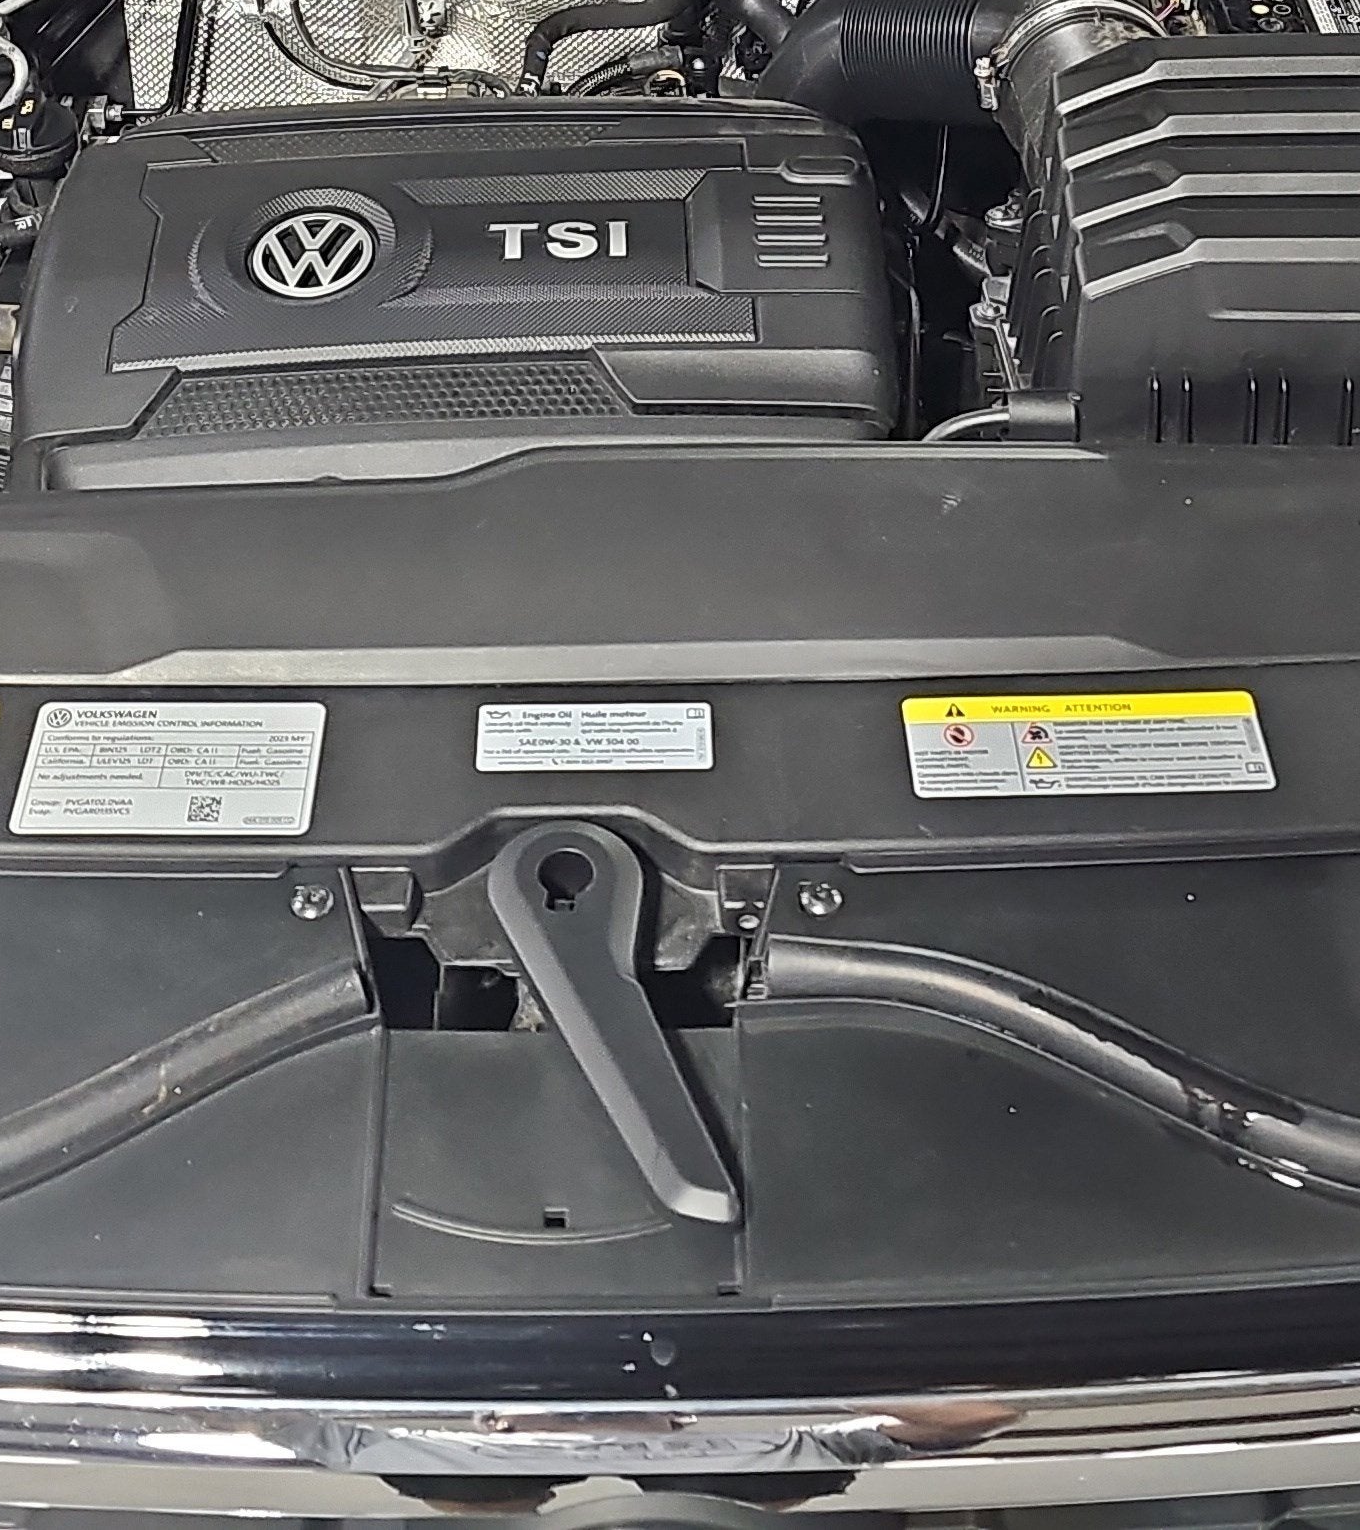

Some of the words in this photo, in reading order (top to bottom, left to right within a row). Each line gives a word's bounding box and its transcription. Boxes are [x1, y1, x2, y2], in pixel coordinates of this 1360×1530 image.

[487, 220, 630, 260] TSI
[76, 709, 158, 719] VOLKSWAGEN
[991, 704, 1051, 715] WARNING
[1064, 703, 1132, 713] ATTENTION
[522, 710, 555, 720] Engine
[557, 710, 572, 719] Oil
[581, 710, 607, 719] Huile
[609, 710, 647, 719] moteur
[201, 720, 263, 728] INFORMATION
[585, 738, 603, 746] VW
[606, 738, 624, 746] 504
[626, 738, 640, 746] 00
